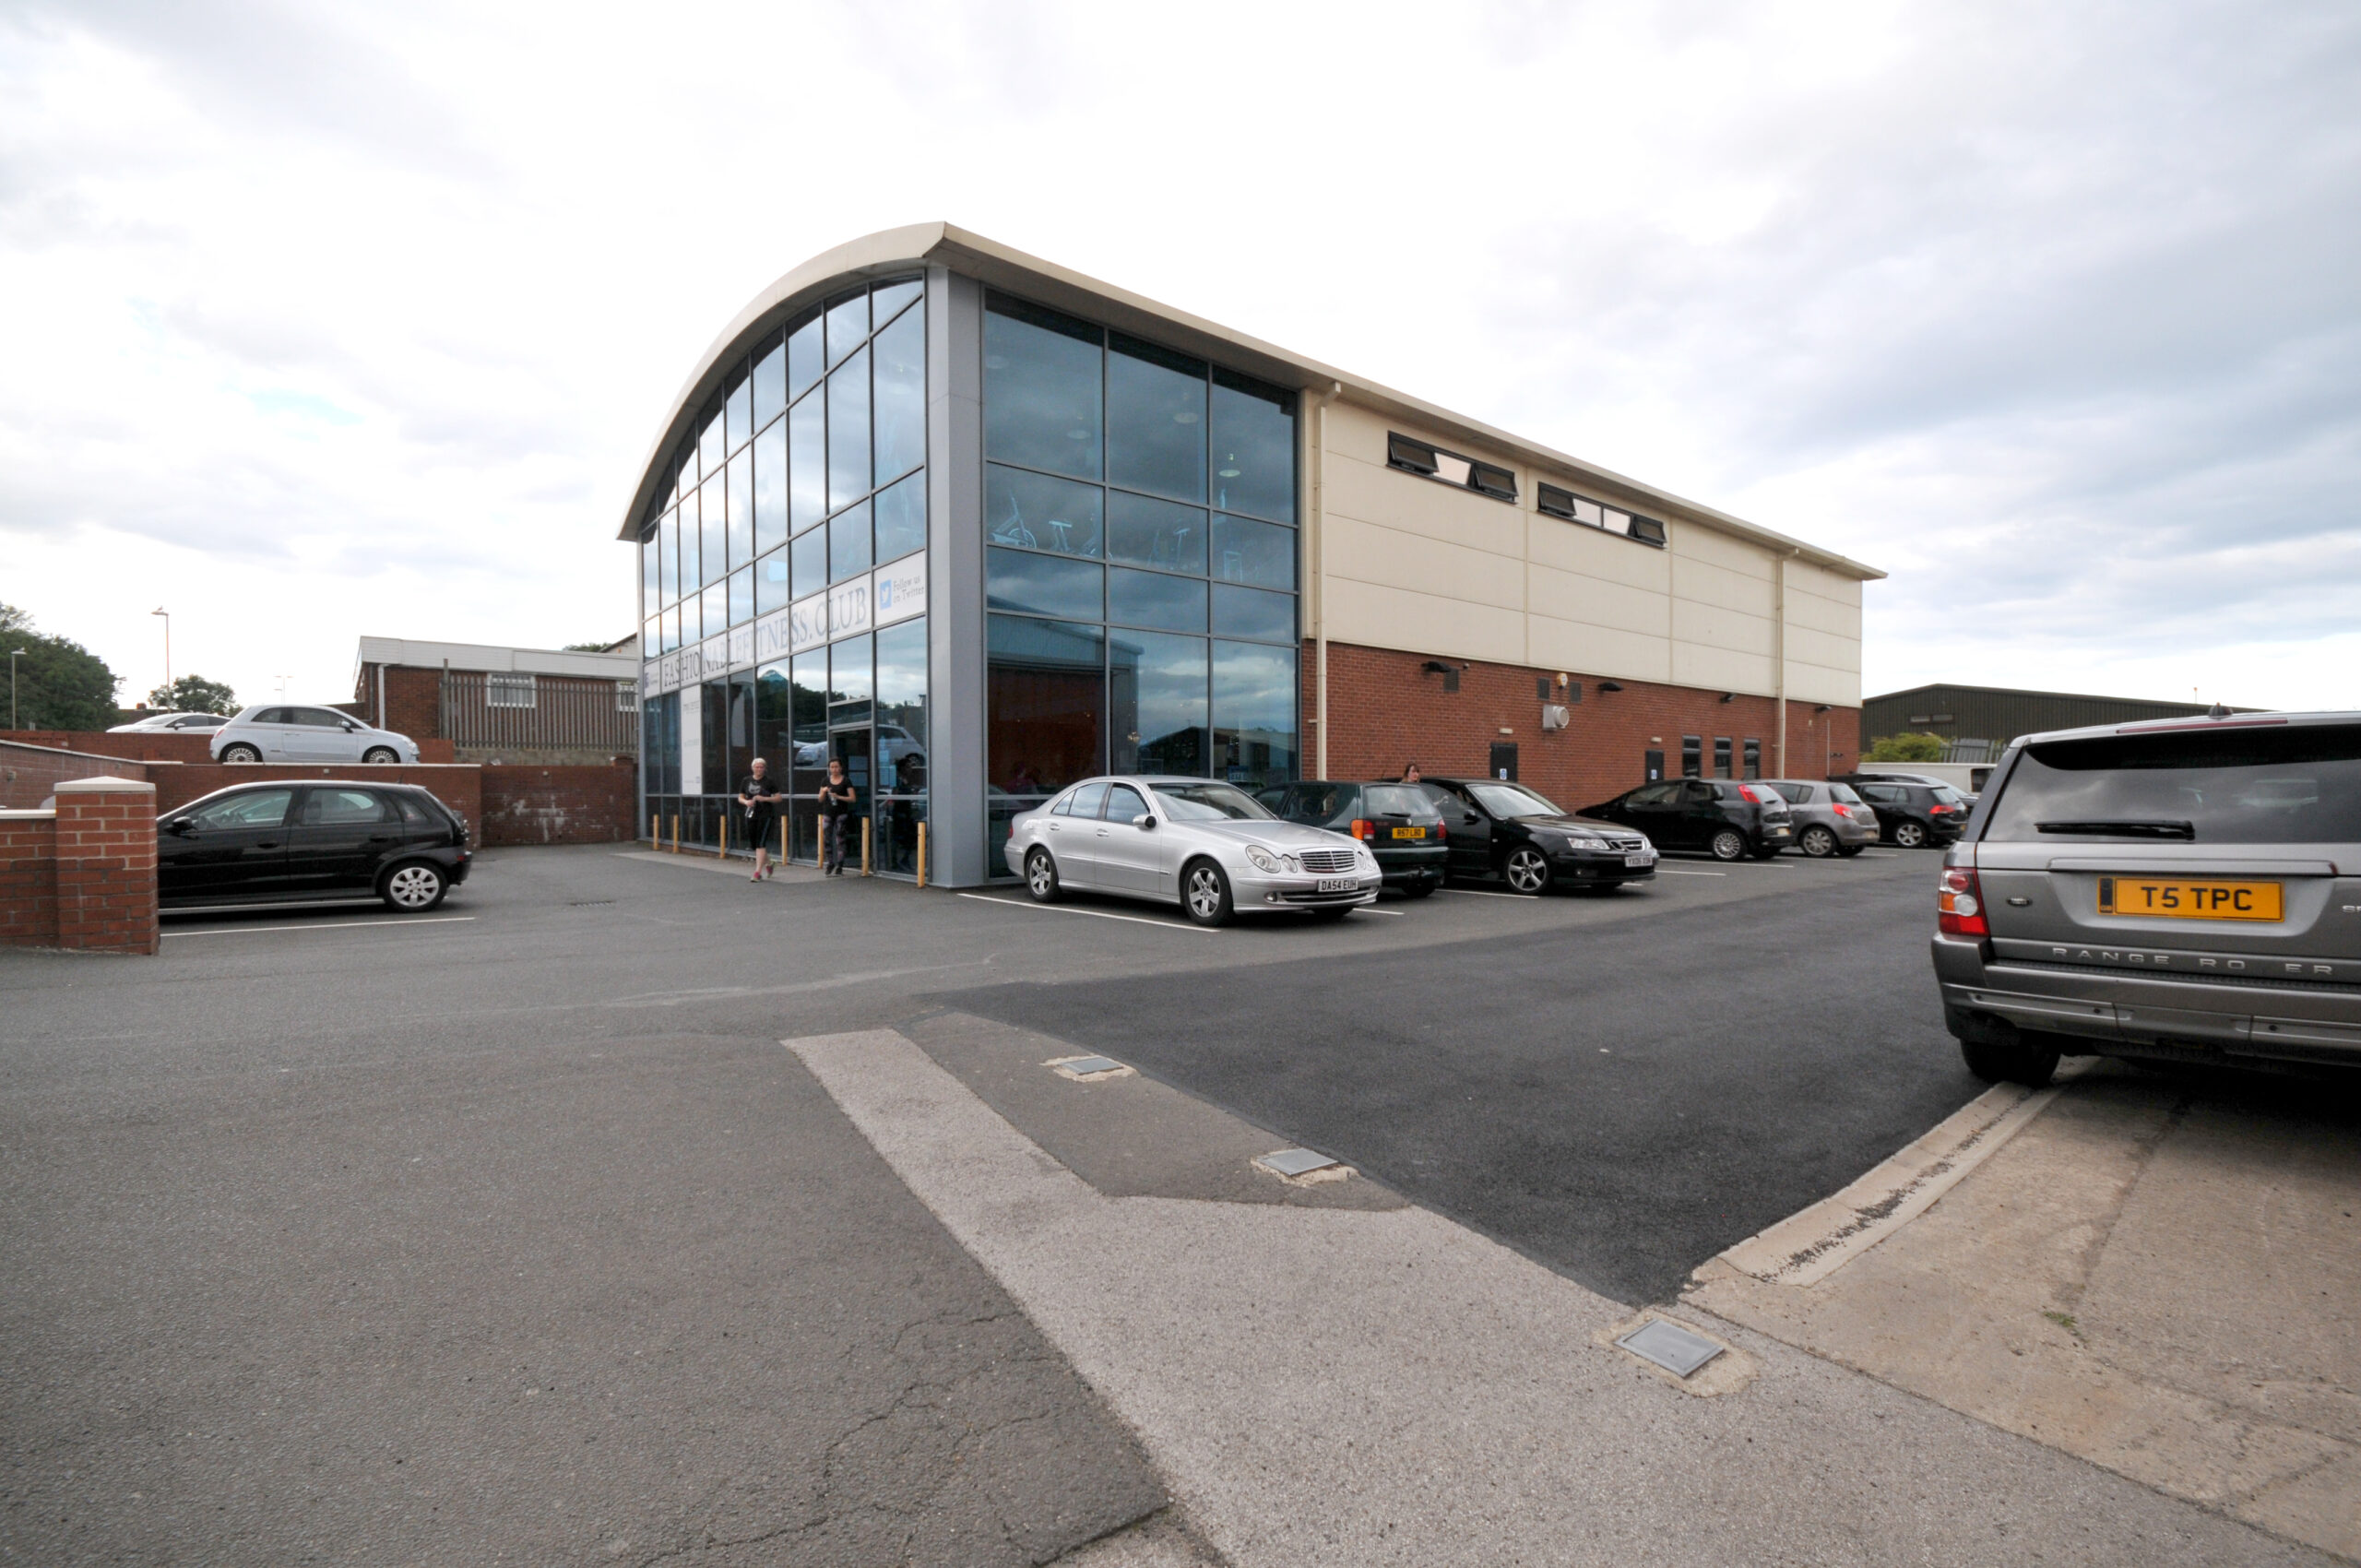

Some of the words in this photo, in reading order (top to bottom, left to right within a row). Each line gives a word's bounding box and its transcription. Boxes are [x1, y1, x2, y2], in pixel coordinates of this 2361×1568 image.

[893, 578, 912, 591] Follow
[913, 576, 920, 585] us
[893, 595, 901, 603] on
[902, 587, 924, 600] Twitter
[2141, 886, 2179, 909] T5
[2189, 887, 2252, 911] TPC
[2052, 947, 2170, 965] RANGE
